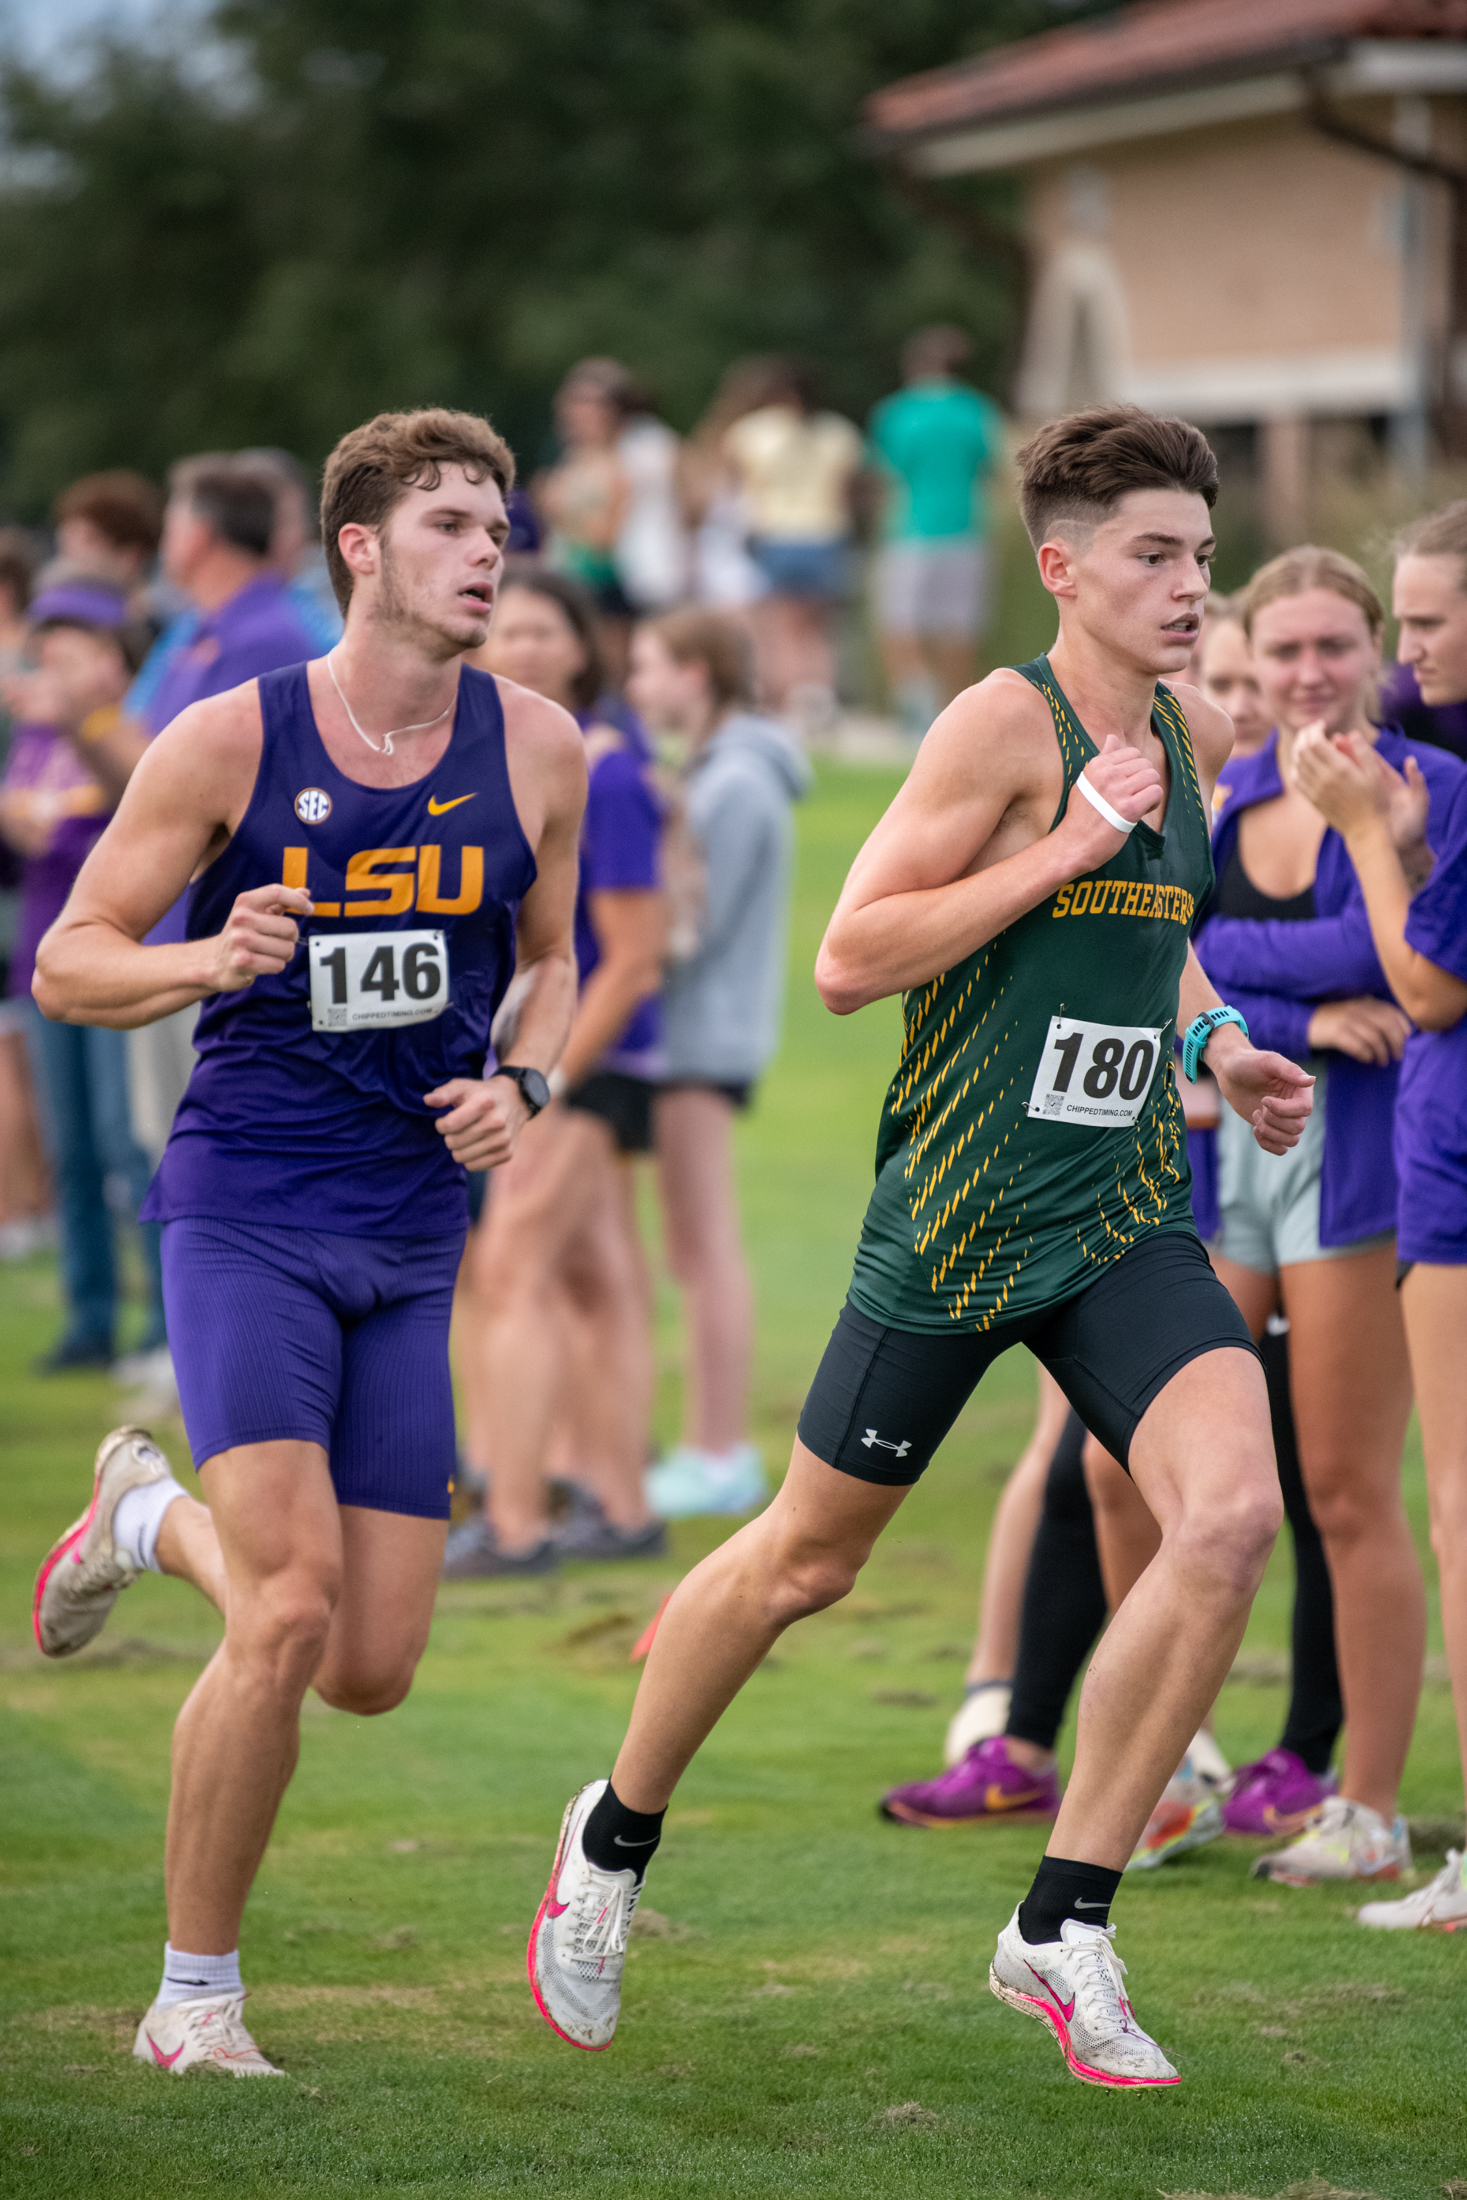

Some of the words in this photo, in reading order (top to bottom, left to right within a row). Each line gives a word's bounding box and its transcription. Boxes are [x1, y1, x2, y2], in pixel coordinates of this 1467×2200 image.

[298, 790, 330, 821] SEC
[282, 845, 484, 917] LSU
[320, 942, 441, 1004] 146
[352, 1008, 433, 1021] CHIPPEDTIMING.COM
[1052, 1032, 1154, 1101] 180
[1066, 1104, 1133, 1117] CHIPPEDTIMING.COM
